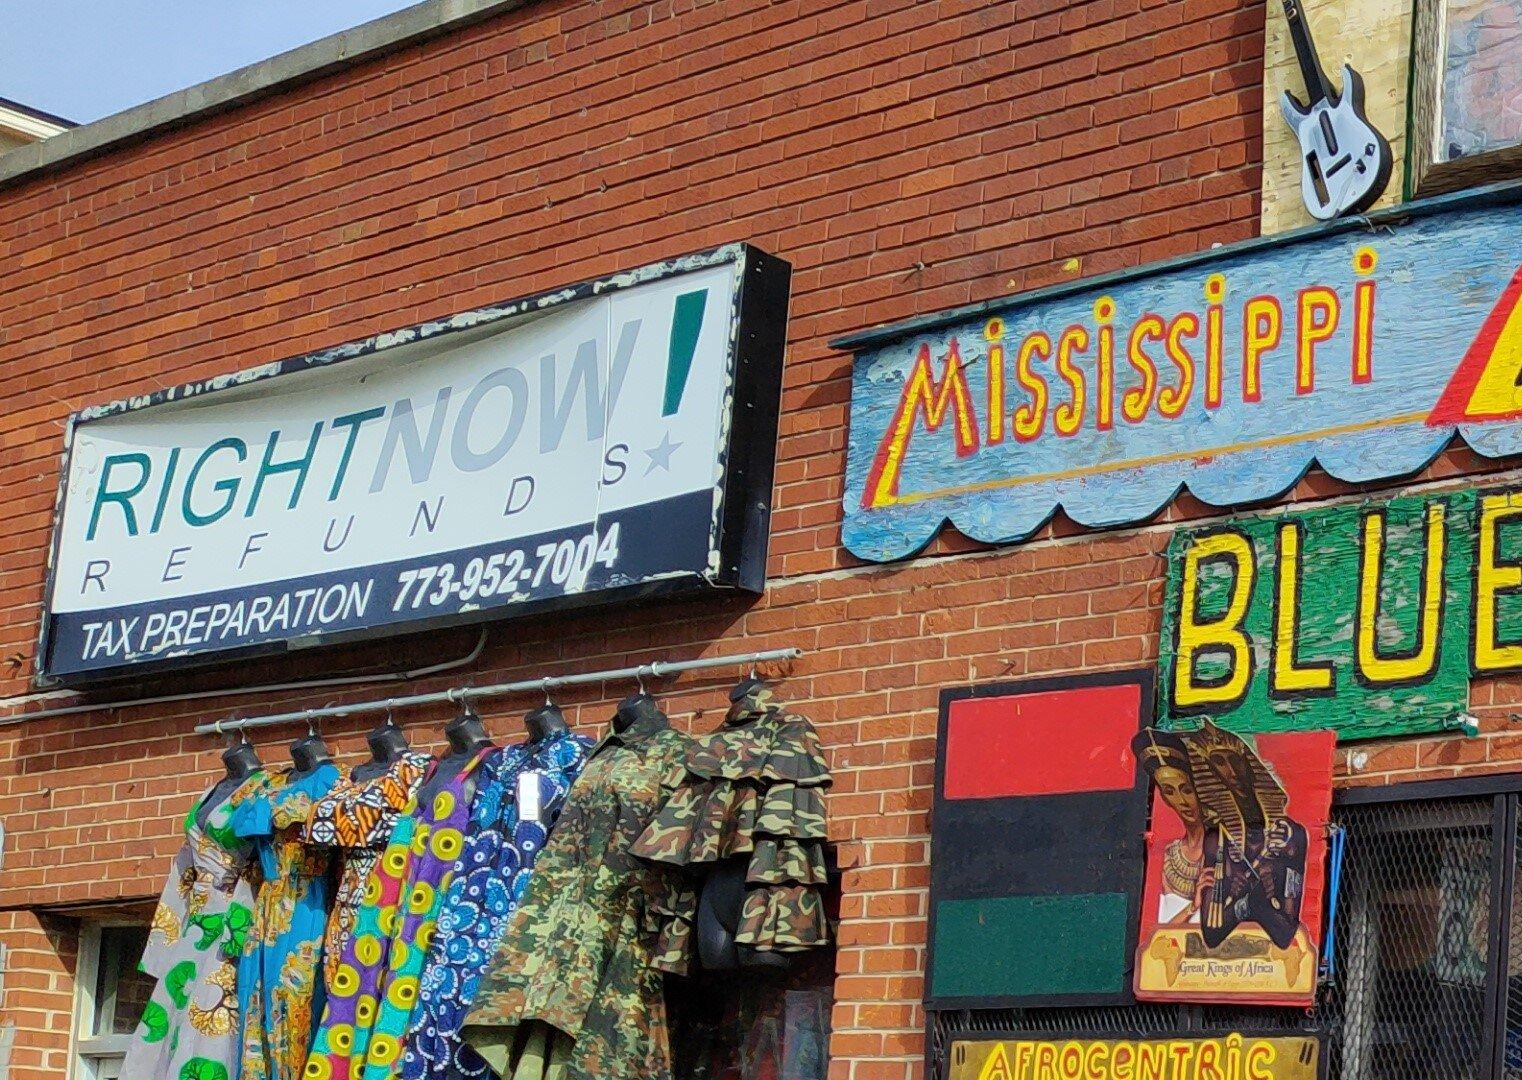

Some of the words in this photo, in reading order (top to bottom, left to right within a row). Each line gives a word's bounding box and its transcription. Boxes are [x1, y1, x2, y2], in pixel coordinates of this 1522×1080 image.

[81, 443, 630, 594] REFUNDS
[81, 619, 140, 661] TAX
[141, 578, 374, 653] PREPARATION
[391, 522, 620, 612] 773-952-7004
[1180, 961, 1205, 976] Great
[1205, 961, 1232, 977] Kings
[1235, 961, 1246, 977] of
[1245, 961, 1274, 977] Africa
